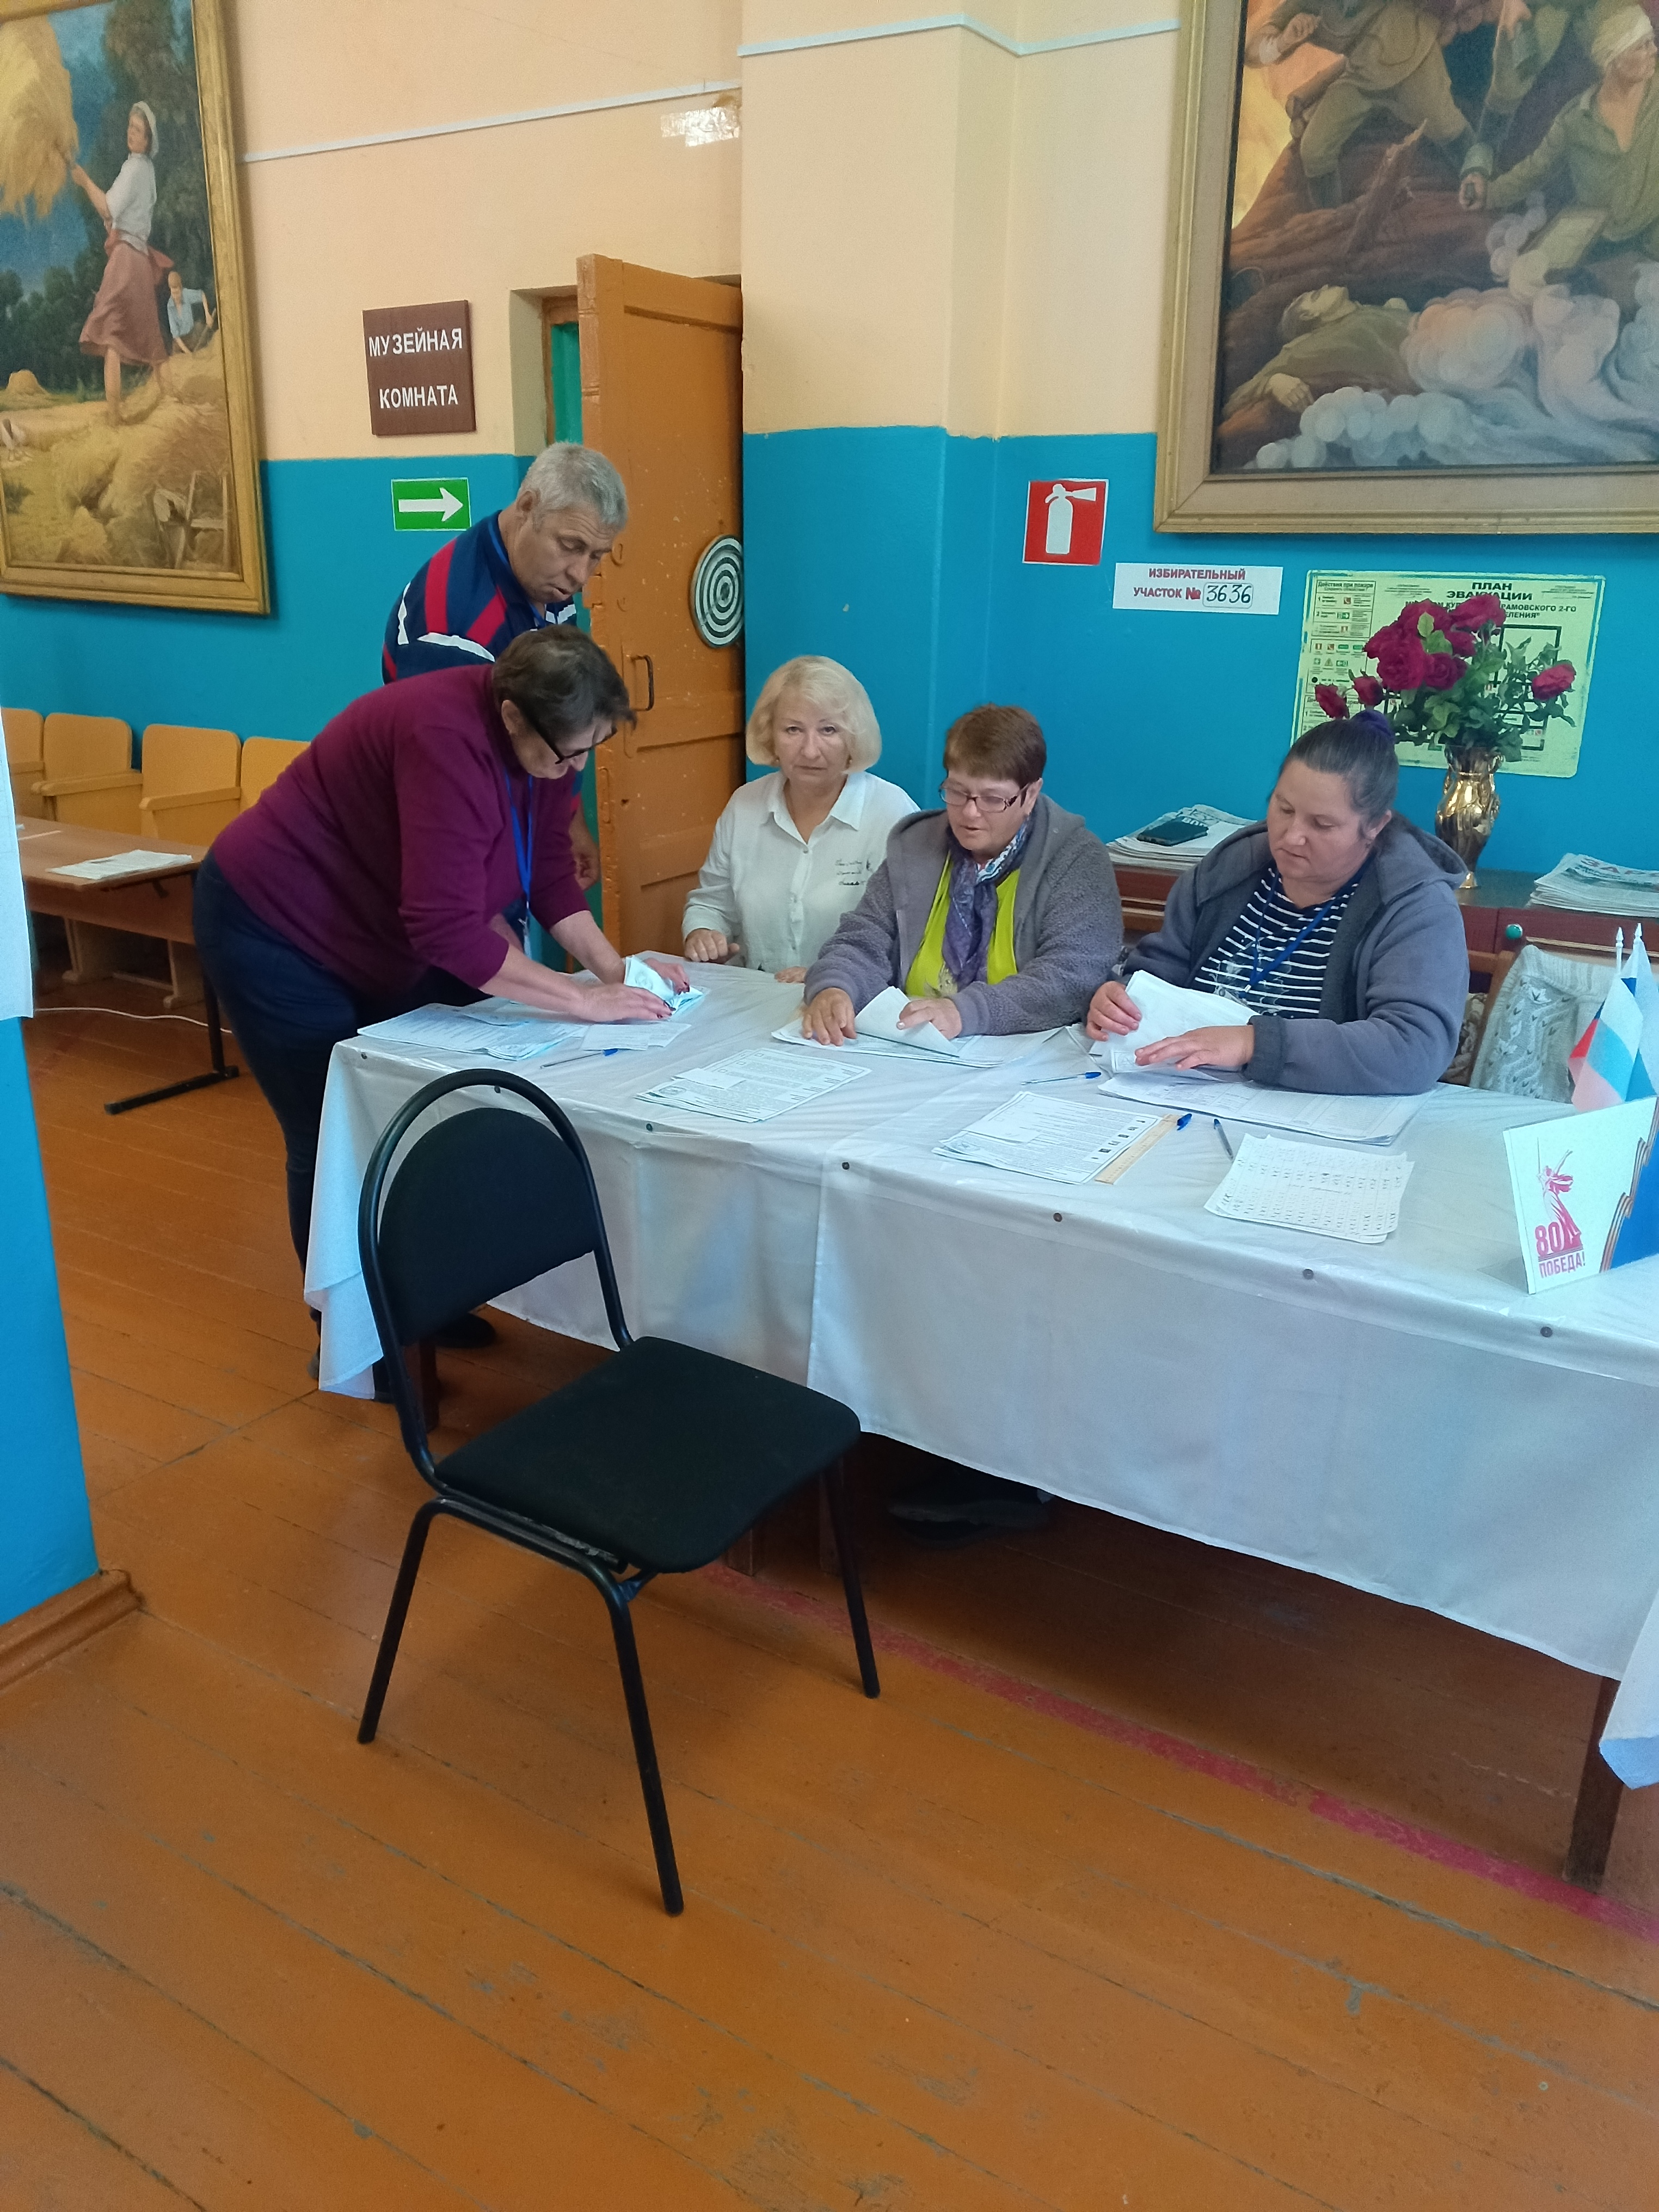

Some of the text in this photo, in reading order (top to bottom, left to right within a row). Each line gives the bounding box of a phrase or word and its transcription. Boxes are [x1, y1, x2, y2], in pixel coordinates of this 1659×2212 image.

[368, 327, 463, 357] МУЗЕЙНАЯ
[379, 384, 458, 409] КОМНАТА
[1148, 568, 1246, 580] ИЗБИРАТЕЛЬНЫЙ
[1472, 582, 1512, 591] ПЛАН
[1134, 584, 1251, 603] УЧАСТОК № 3636
[1535, 1222, 1562, 1257] 80
[1538, 1251, 1586, 1279] ПОБЕДА!
